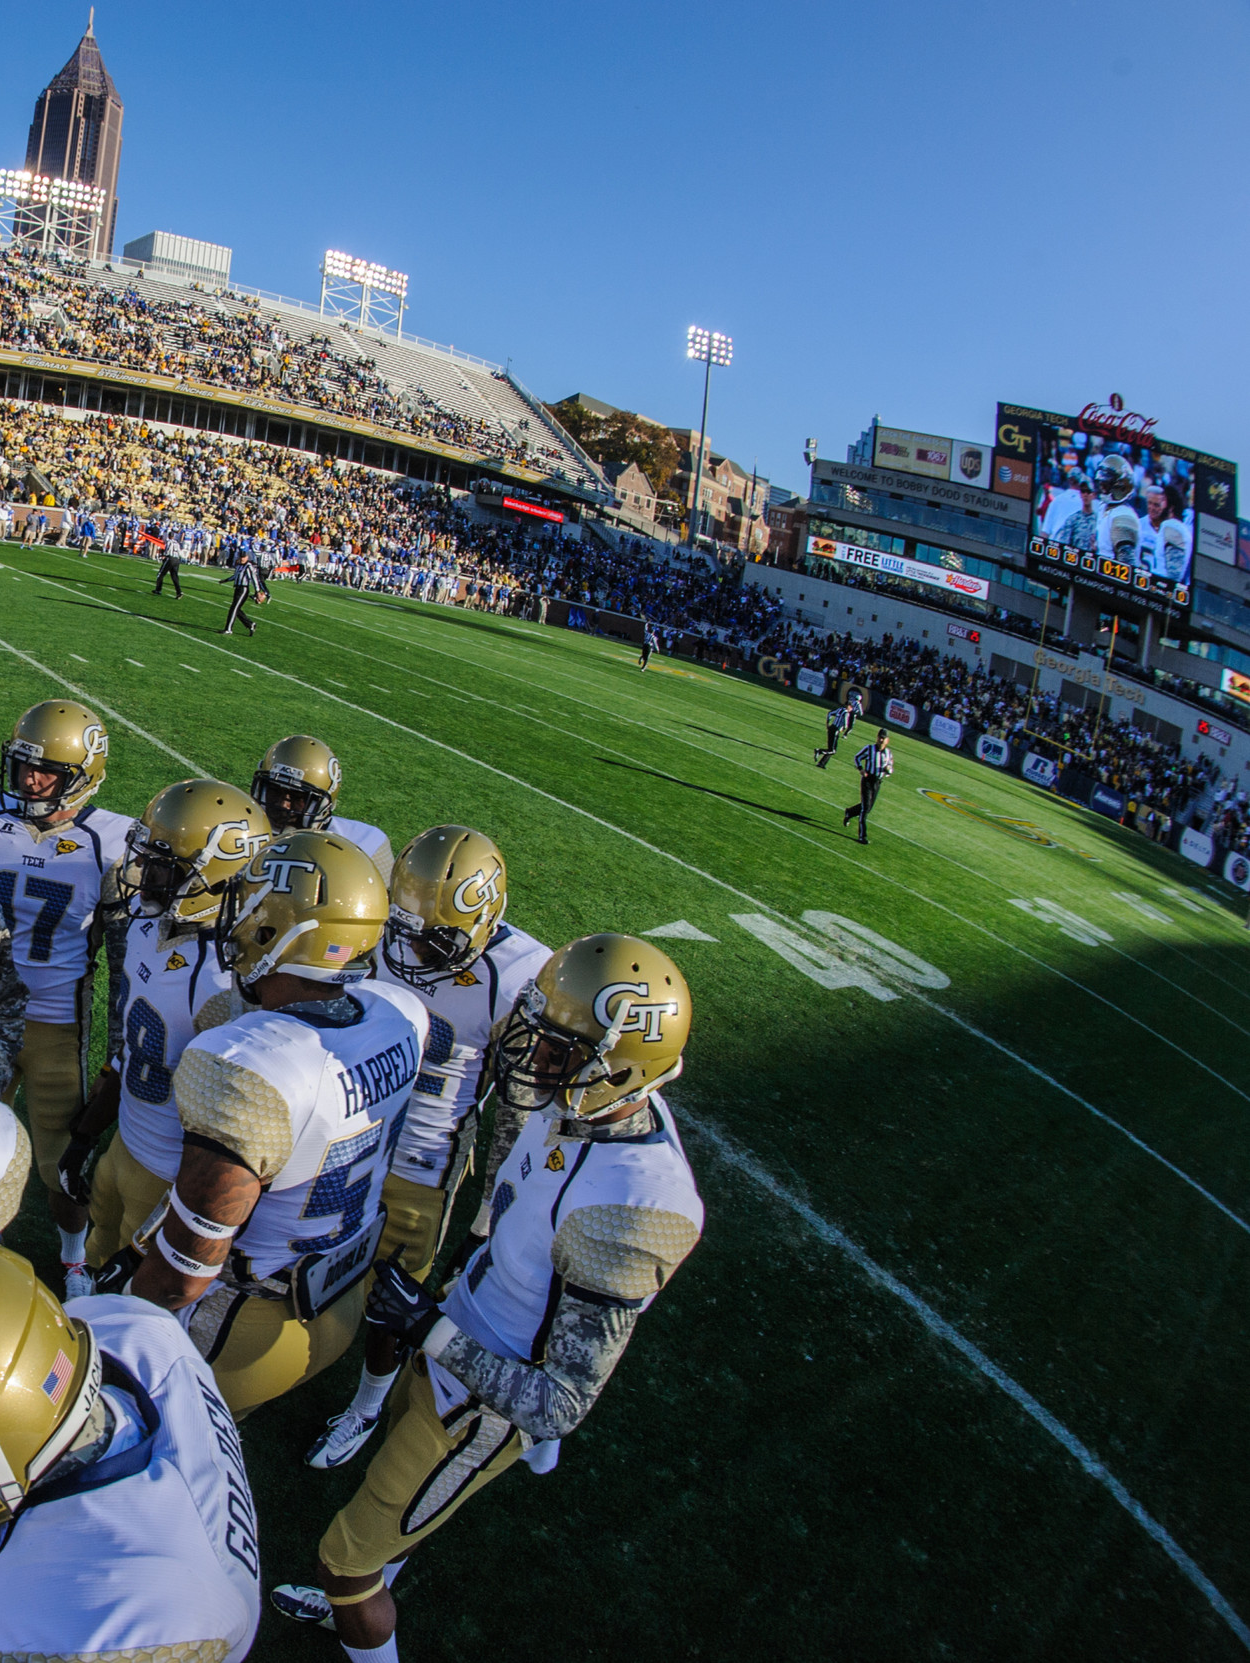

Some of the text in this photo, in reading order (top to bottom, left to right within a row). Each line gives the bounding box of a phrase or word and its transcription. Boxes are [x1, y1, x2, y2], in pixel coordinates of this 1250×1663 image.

[21, 359, 69, 371] HEISMAN
[97, 371, 147, 384] STRUPPER
[240, 399, 293, 414] ALEXANDER
[1003, 405, 1069, 425] GEORGIA TECH
[999, 424, 1032, 452] GT
[961, 456, 981, 474] ups
[831, 466, 877, 483] WELCOME
[880, 475, 894, 486] TO
[896, 479, 930, 495] BOBBY
[932, 486, 962, 501] DODD
[963, 493, 1009, 512] STADIUM
[846, 547, 881, 567] FREE
[1103, 560, 1130, 580] 0:12
[1034, 649, 1146, 705] Georgia Tech
[58, 842, 75, 851] ACC
[208, 819, 271, 861] GT
[22, 854, 46, 869] TECH
[452, 866, 502, 915] GT
[592, 981, 678, 1044] GT
